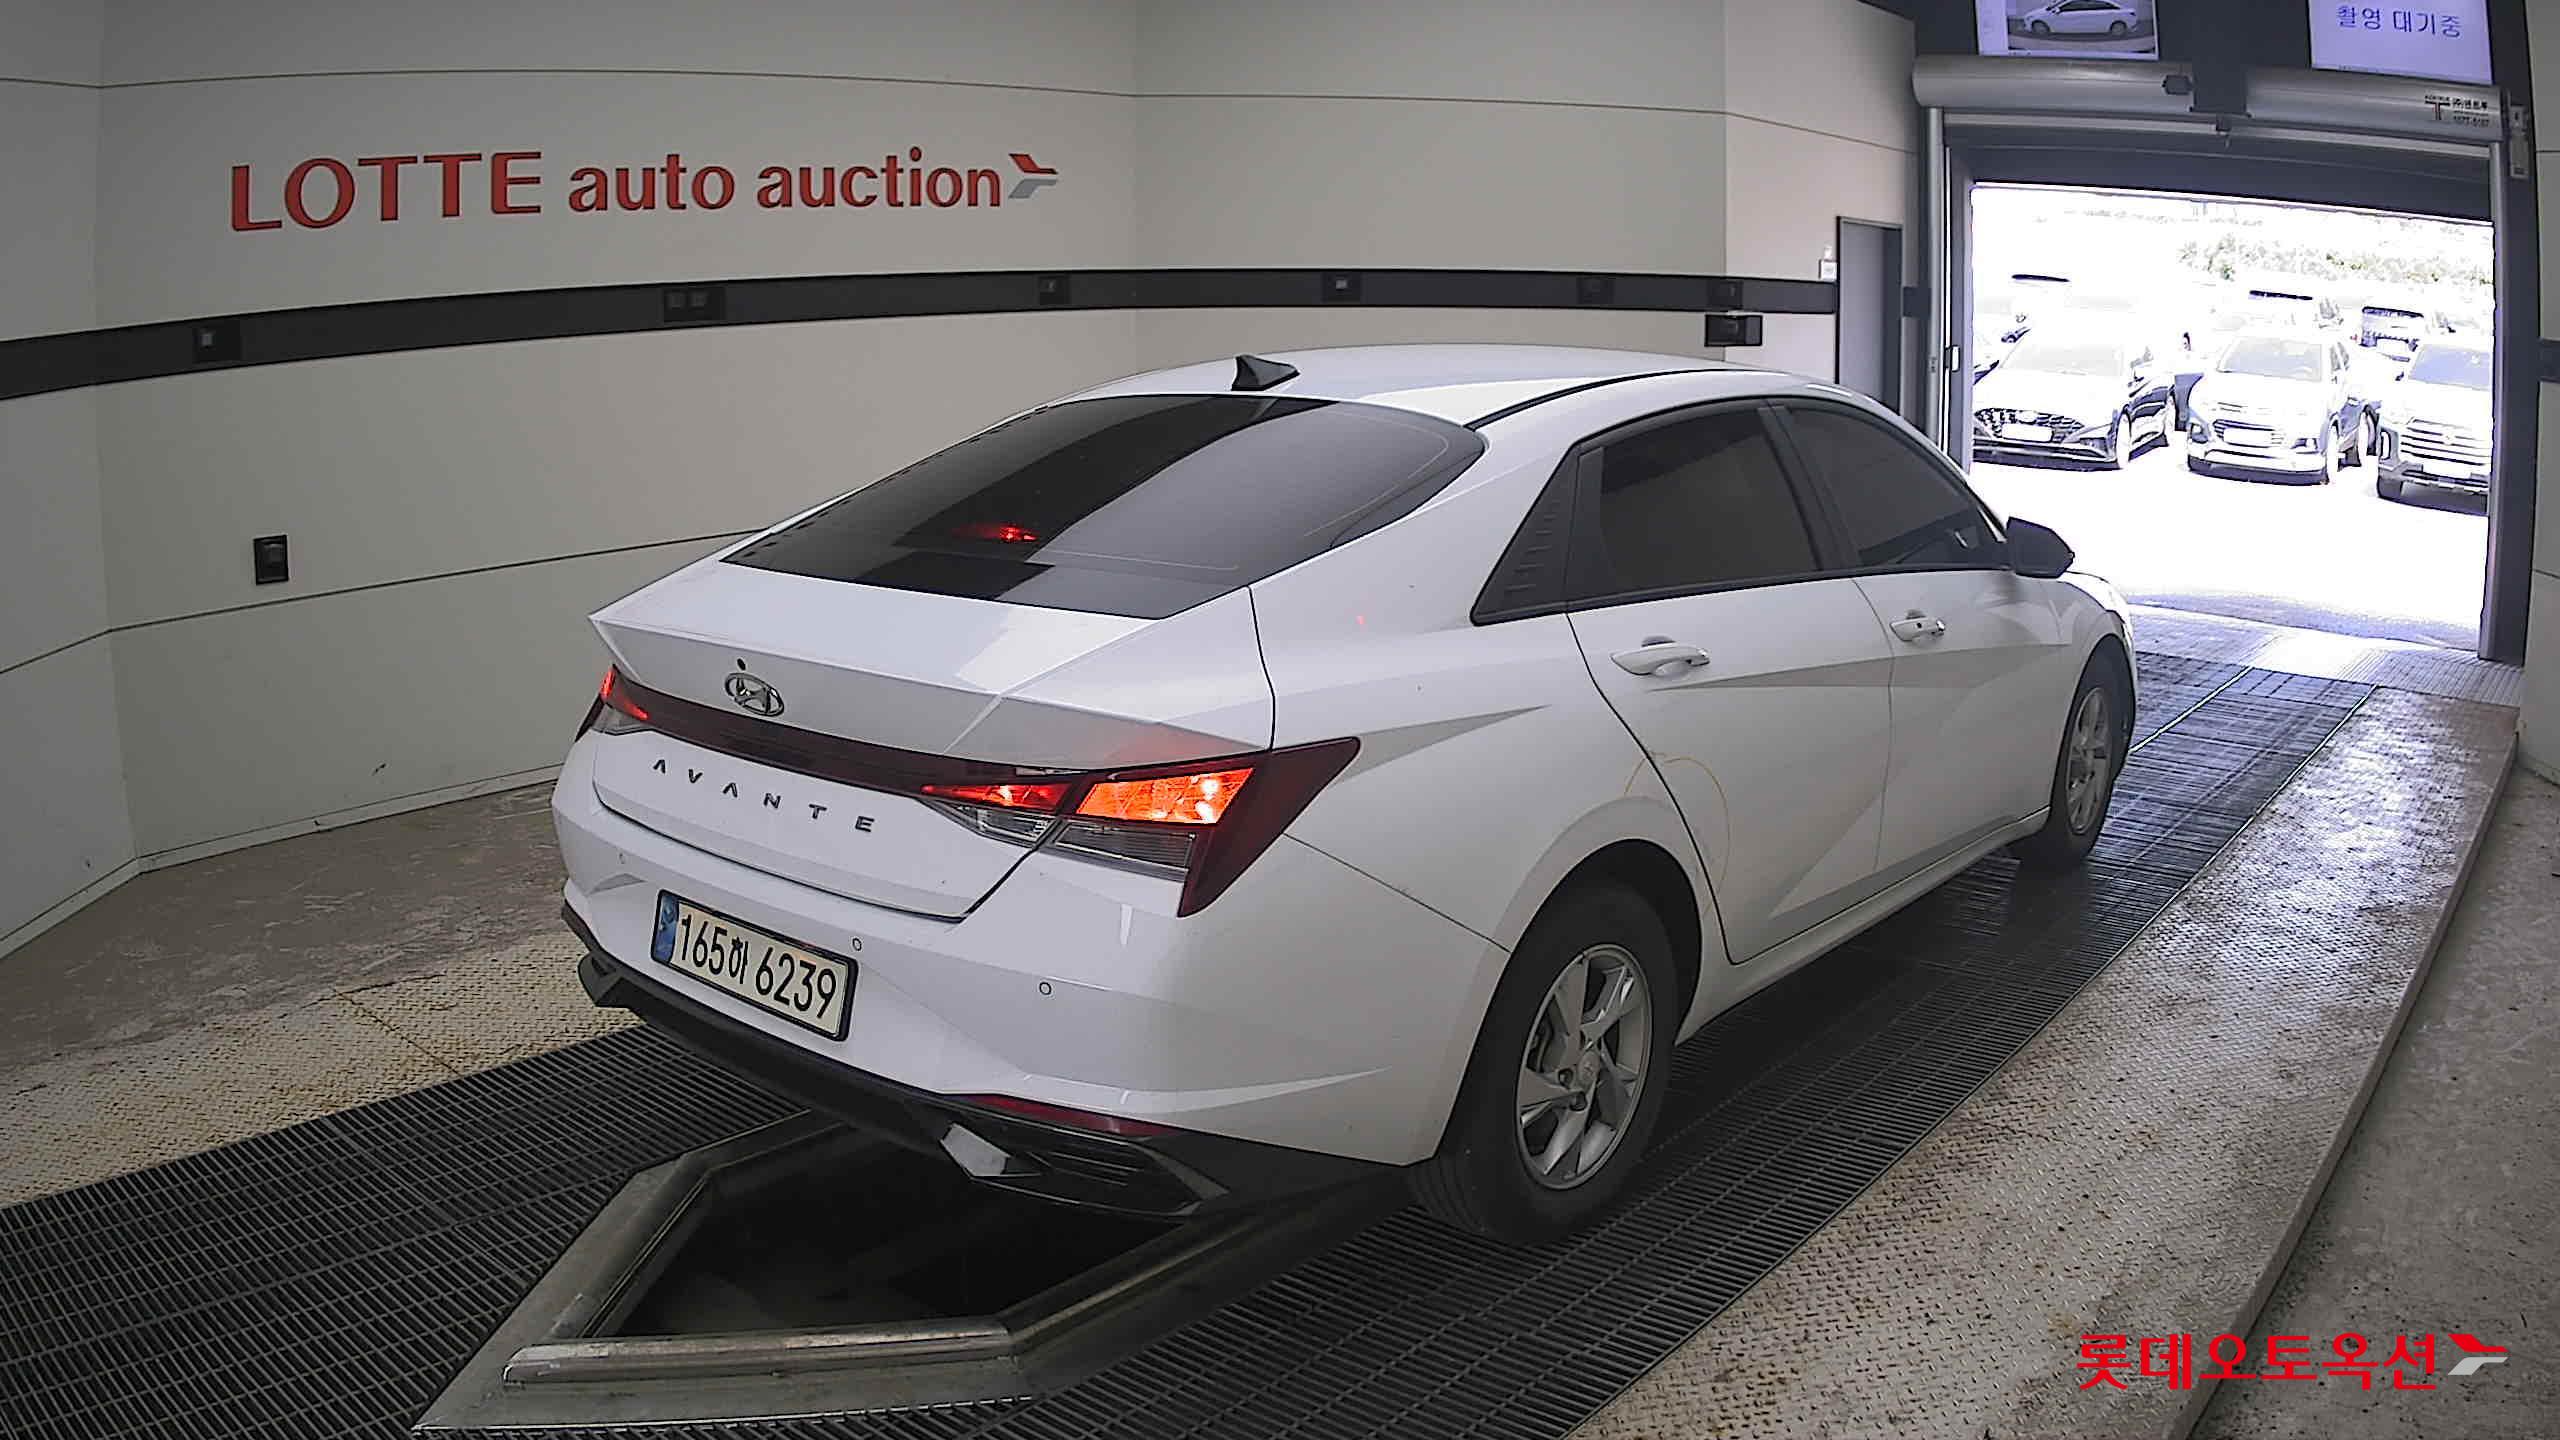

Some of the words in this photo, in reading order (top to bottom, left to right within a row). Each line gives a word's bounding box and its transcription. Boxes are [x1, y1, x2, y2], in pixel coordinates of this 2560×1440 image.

[2337, 5, 2382, 31] 촬영
[2392, 11, 2461, 38] 대기중
[231, 150, 542, 231] LOTTE
[568, 153, 735, 211] auto
[757, 146, 1000, 209] auction
[653, 759, 875, 832] AVANTE
[681, 914, 749, 985] 165하
[755, 947, 837, 1018] 6239
